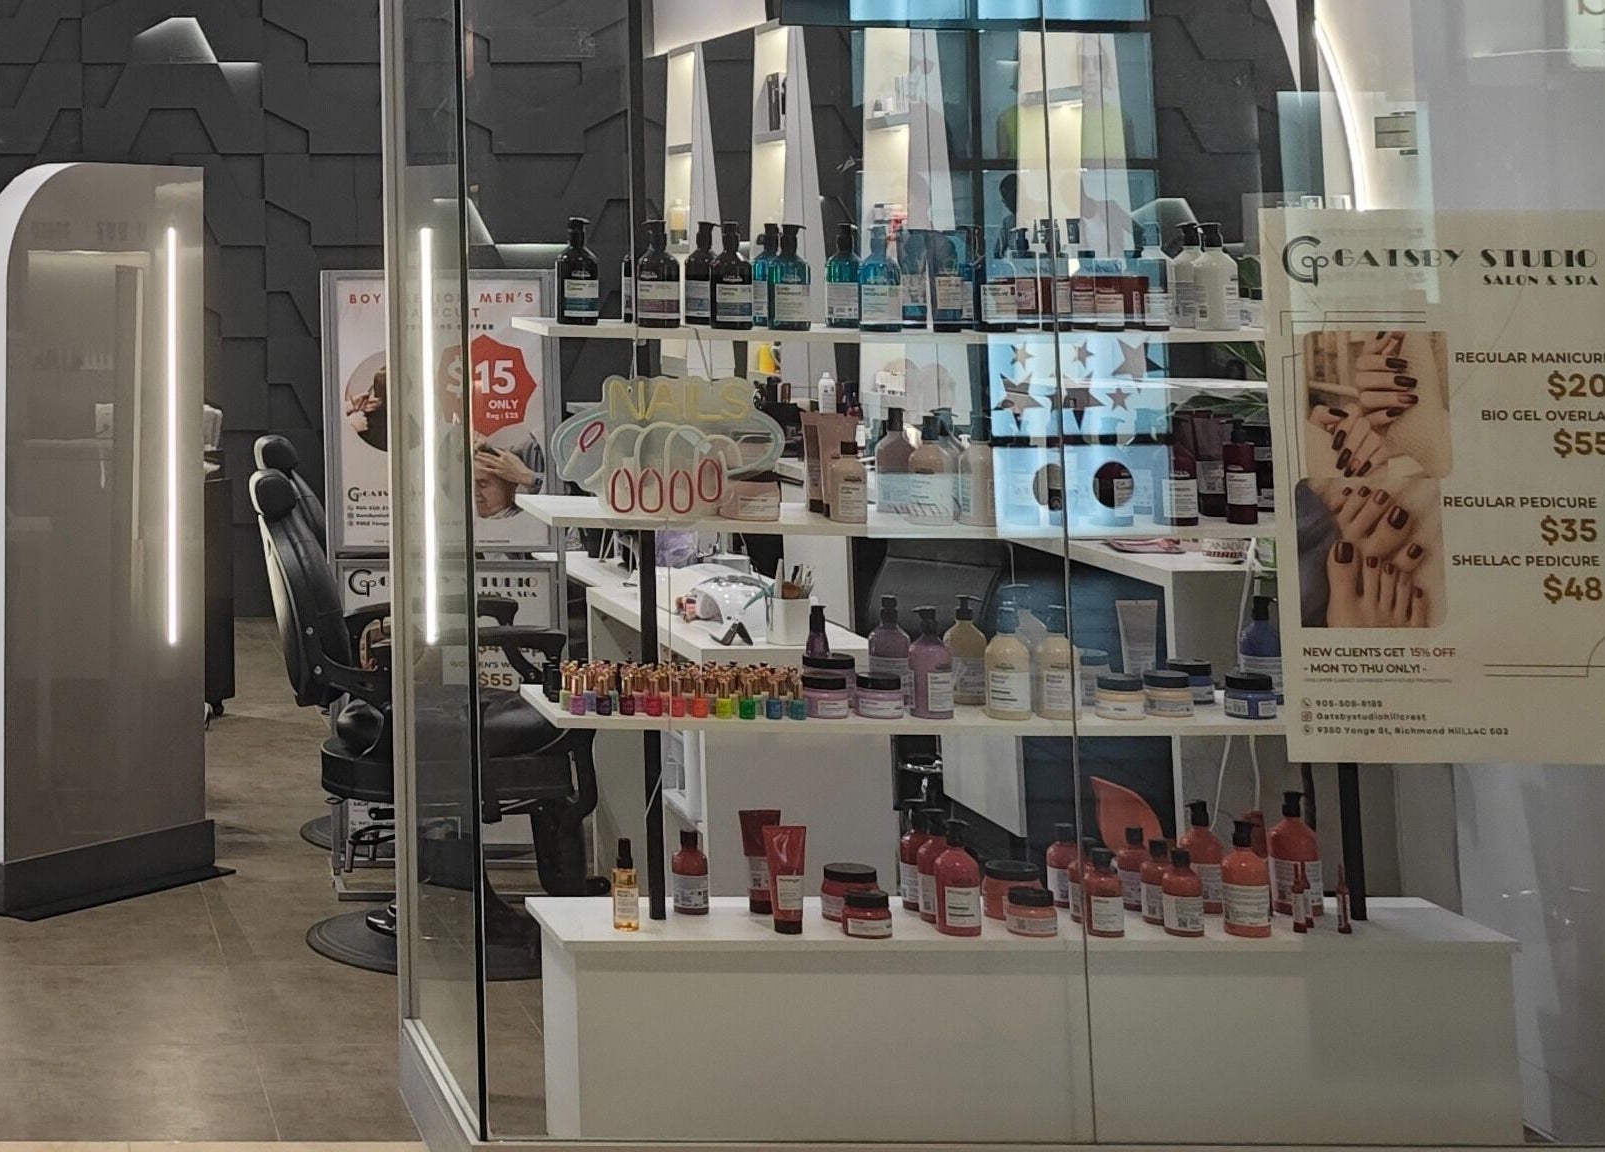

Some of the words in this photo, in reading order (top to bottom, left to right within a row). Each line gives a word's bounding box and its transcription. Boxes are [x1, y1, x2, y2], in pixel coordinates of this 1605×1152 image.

[1333, 249, 1464, 267] GATSBY
[1481, 248, 1598, 268] STUDIO
[1483, 275, 1539, 286] SALON
[1565, 275, 1598, 286] SPA
[479, 292, 534, 304] MEN'S
[1455, 352, 1527, 363] REGULAR
[1547, 370, 1605, 400] $20
[488, 399, 519, 409] ONLY
[608, 379, 750, 422] NAILS
[1482, 410, 1507, 421] BIO
[1512, 410, 1542, 421] GEL
[1553, 428, 1605, 458] $55
[1444, 496, 1515, 508] REGULAR
[1520, 497, 1598, 509] PEDICURE
[1540, 515, 1598, 545] $35
[1452, 554, 1521, 567] SHELLAC
[1526, 555, 1601, 567] PEDICURE
[473, 577, 538, 587] TUDIO
[1544, 574, 1603, 604] $48
[1303, 647, 1332, 657] NEW
[1334, 647, 1381, 657] CLIENTS
[1383, 647, 1405, 657] GET
[1432, 647, 1456, 657] OFF
[1310, 663, 1339, 673] MON
[1341, 663, 1358, 673] TO
[1360, 663, 1384, 673] THU
[1386, 663, 1421, 674] ONLY!
[479, 671, 513, 686] $55
